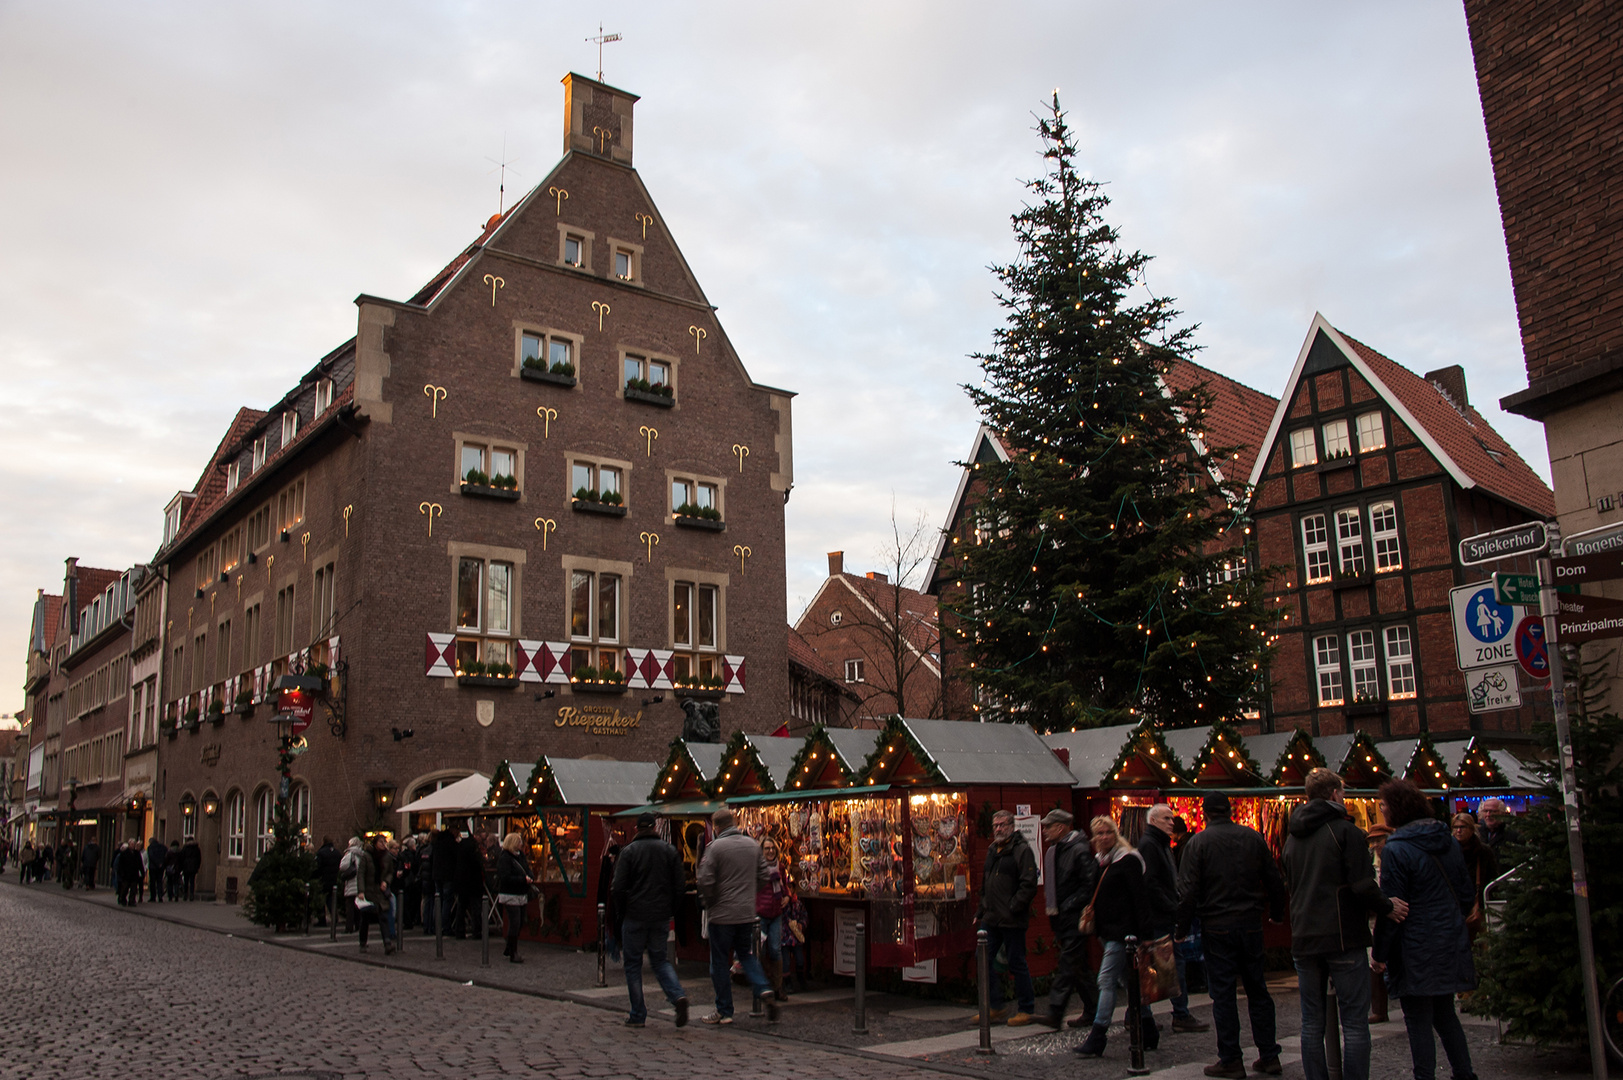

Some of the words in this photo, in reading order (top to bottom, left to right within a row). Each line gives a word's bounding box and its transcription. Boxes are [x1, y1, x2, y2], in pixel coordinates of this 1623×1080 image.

[1470, 530, 1536, 557] Spiekerhof
[1556, 565, 1586, 577] Dom
[1518, 577, 1535, 588] Hotel
[1558, 600, 1585, 613] heater
[1476, 644, 1513, 662] ZONE
[1487, 694, 1504, 706] frei
[583, 705, 613, 714] GROSSER
[554, 706, 643, 733] Kiepenkerl
[593, 727, 628, 736] GASTHAUS
